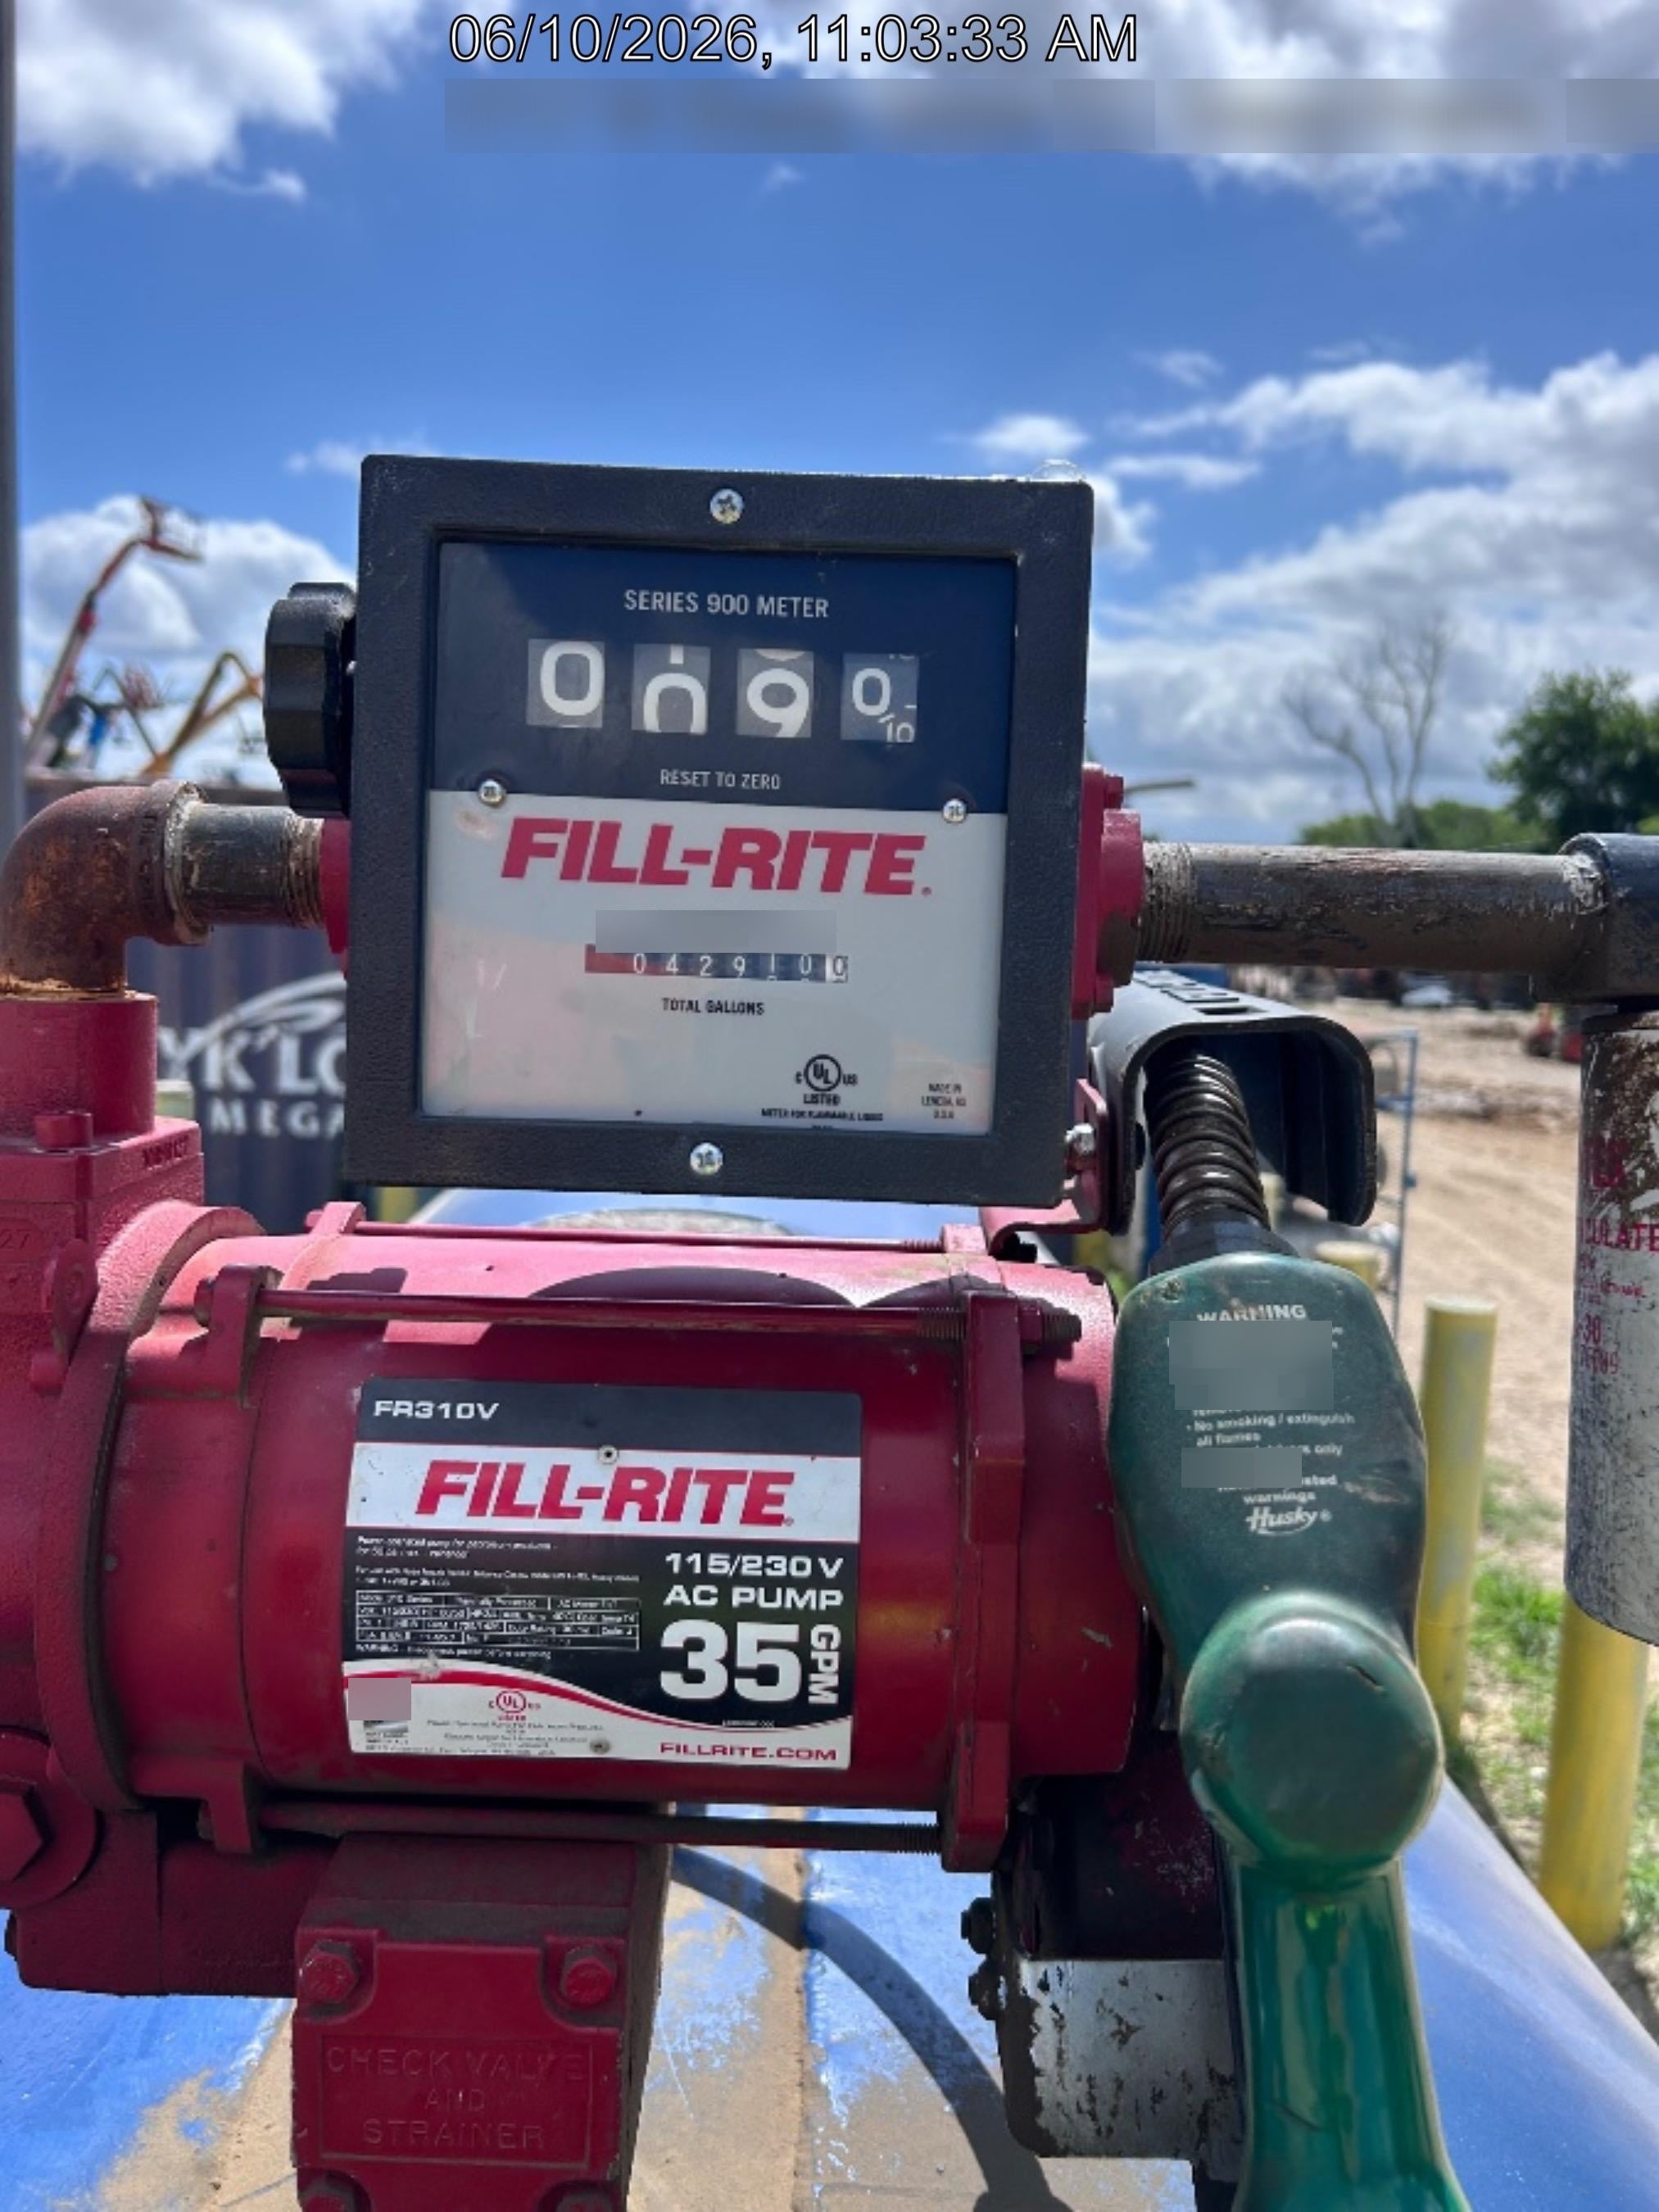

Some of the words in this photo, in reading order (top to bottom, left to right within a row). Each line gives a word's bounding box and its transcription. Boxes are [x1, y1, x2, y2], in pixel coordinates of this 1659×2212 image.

[623, 588, 699, 614] SERIES
[706, 593, 750, 615] 900
[756, 595, 830, 619] METER
[660, 768, 711, 788] RESET
[714, 770, 737, 788] TO
[741, 772, 782, 791] ZERO
[500, 815, 927, 896] FILL-RITE
[661, 997, 700, 1013] TOTAL
[705, 999, 765, 1016] GALLONS
[374, 1400, 499, 1421] FR310V
[1216, 1415, 1276, 1431] smoking
[415, 1459, 795, 1528] FILL-RITE
[665, 1552, 810, 1580] 115/230
[818, 1557, 845, 1579] V
[663, 1584, 719, 1608] AC
[731, 1587, 845, 1610] PUMP
[659, 1619, 803, 1704] 35
[808, 1624, 841, 1706] GPM
[659, 1741, 837, 1761] FILLRITE.COM
[327, 2047, 450, 2078] CHECK
[465, 2051, 585, 2083] VALVE
[424, 2087, 486, 2113] AND
[362, 2118, 546, 2151] STRAINER
